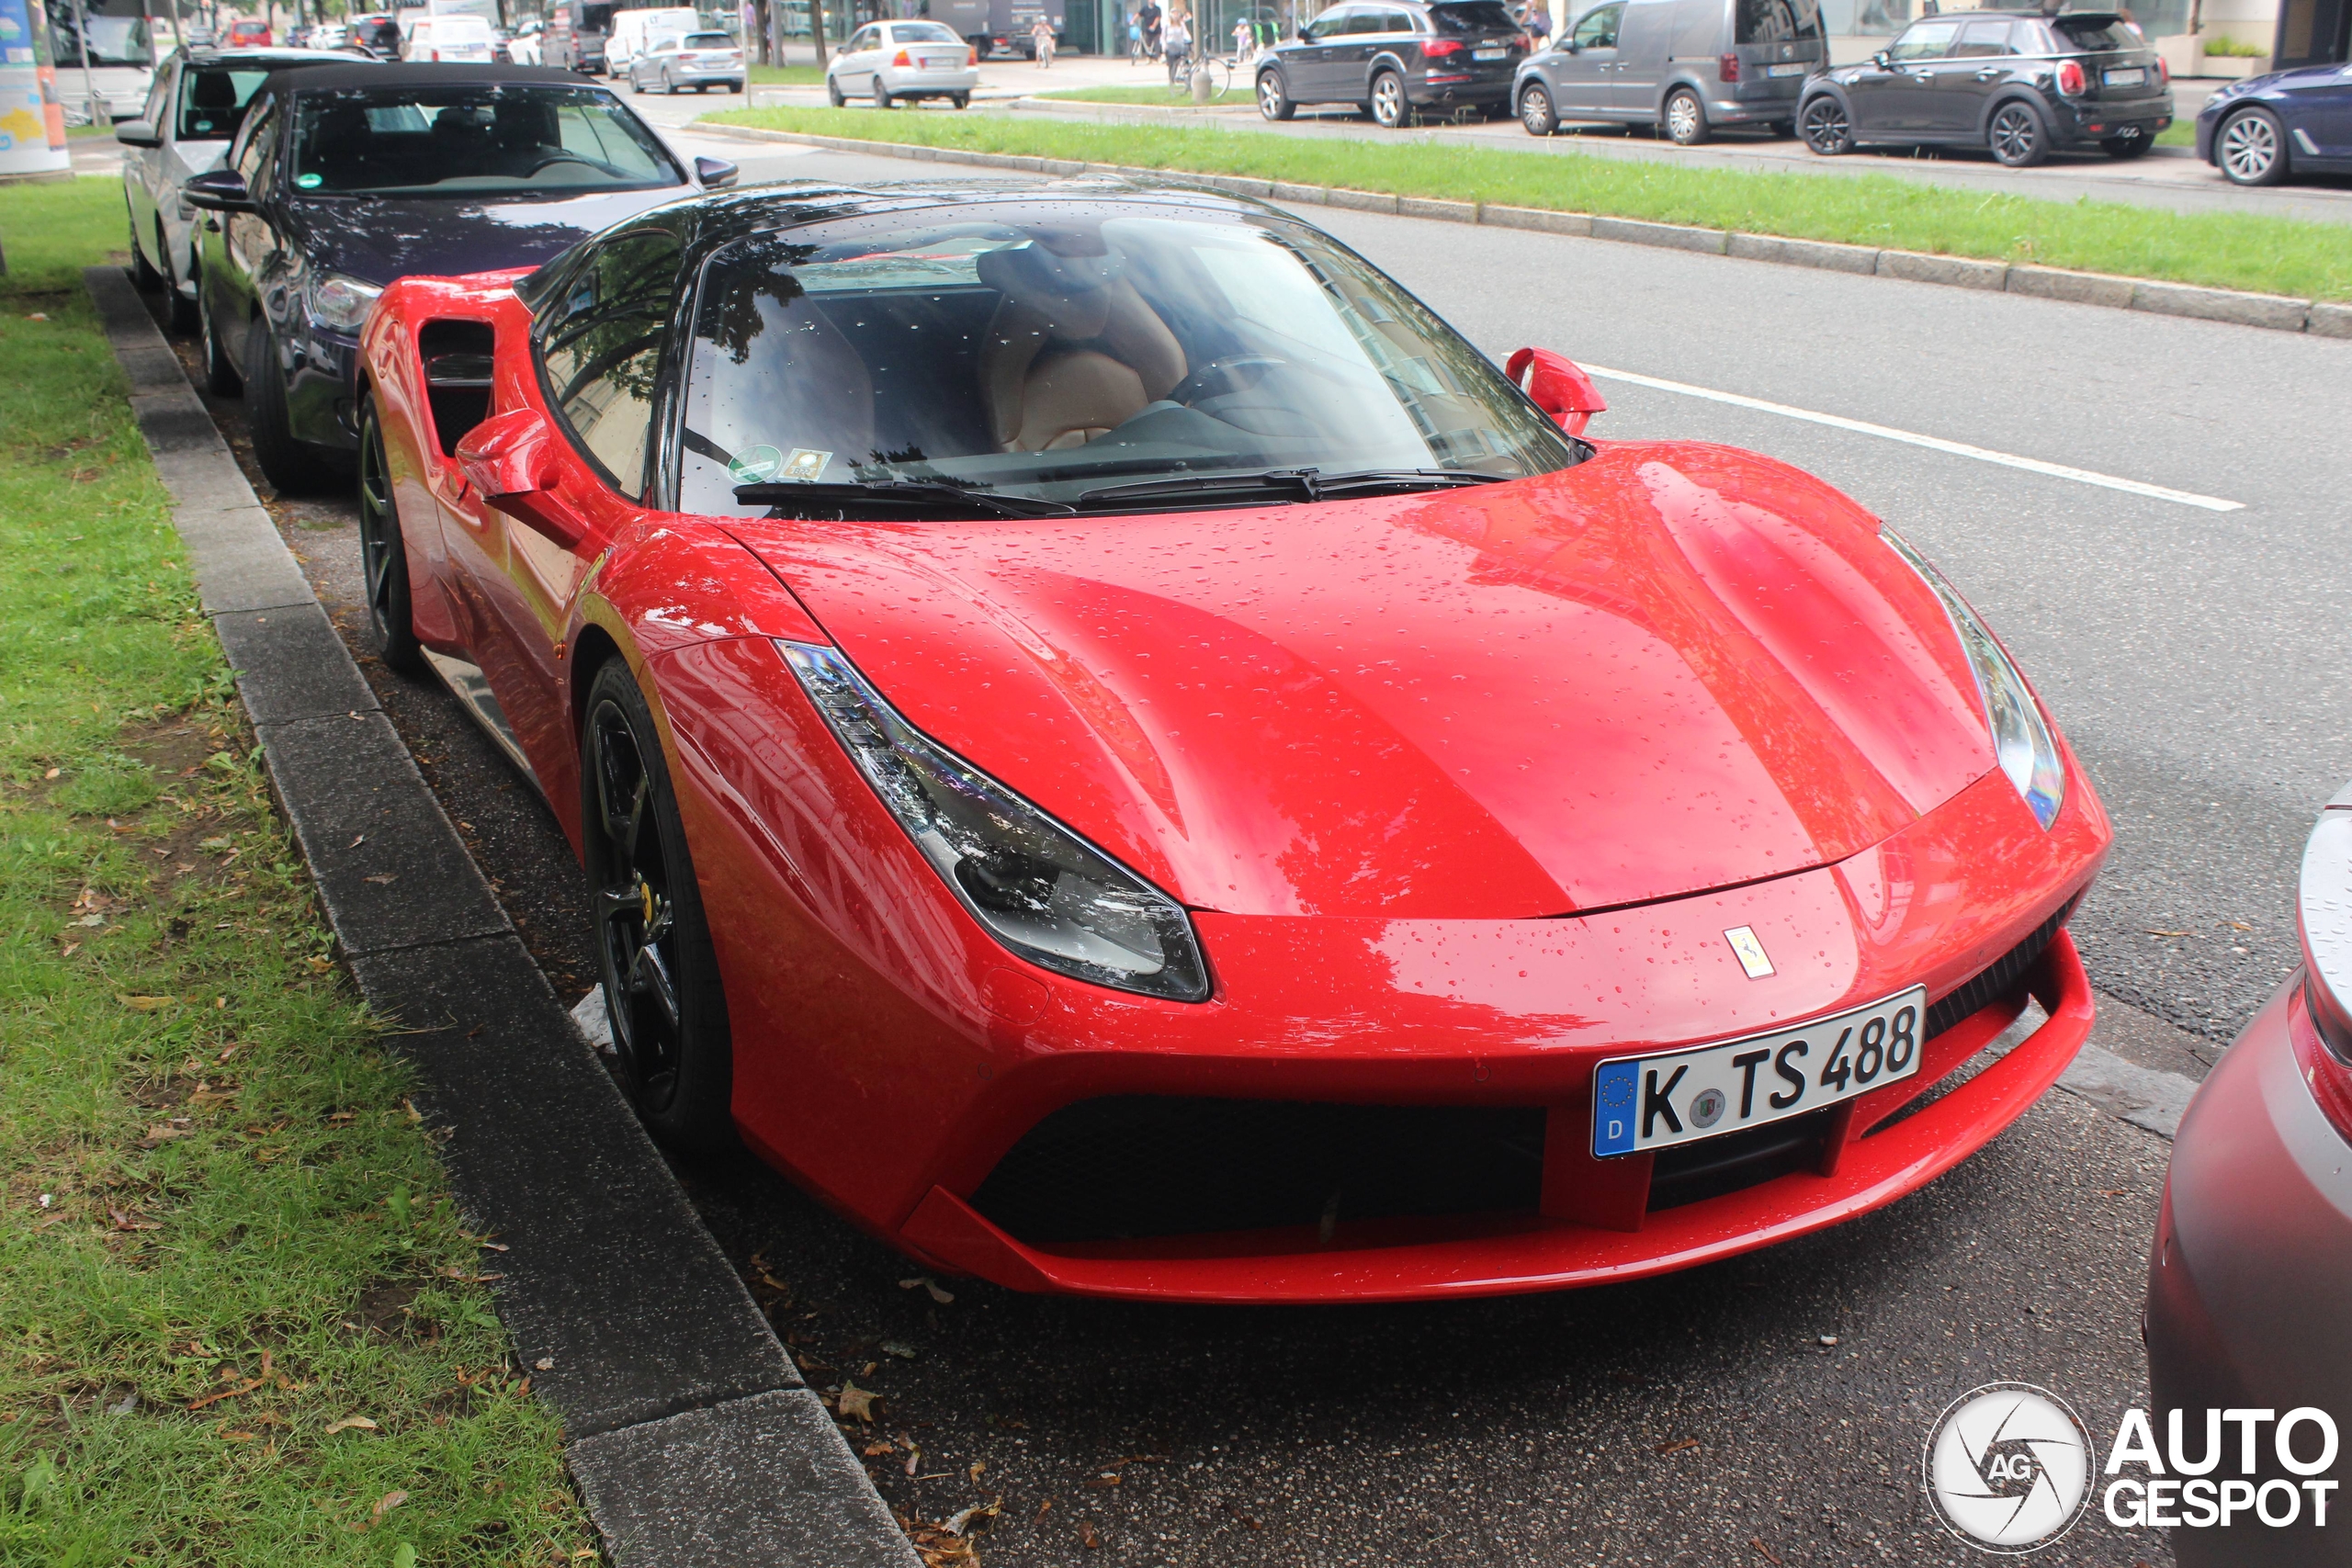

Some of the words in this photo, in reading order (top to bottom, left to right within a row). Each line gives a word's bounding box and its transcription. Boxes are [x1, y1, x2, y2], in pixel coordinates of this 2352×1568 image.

[1642, 1064, 1689, 1138] K
[1733, 1040, 1809, 1119] TS
[1820, 1005, 1916, 1091] 488
[1608, 1120, 1623, 1140] D
